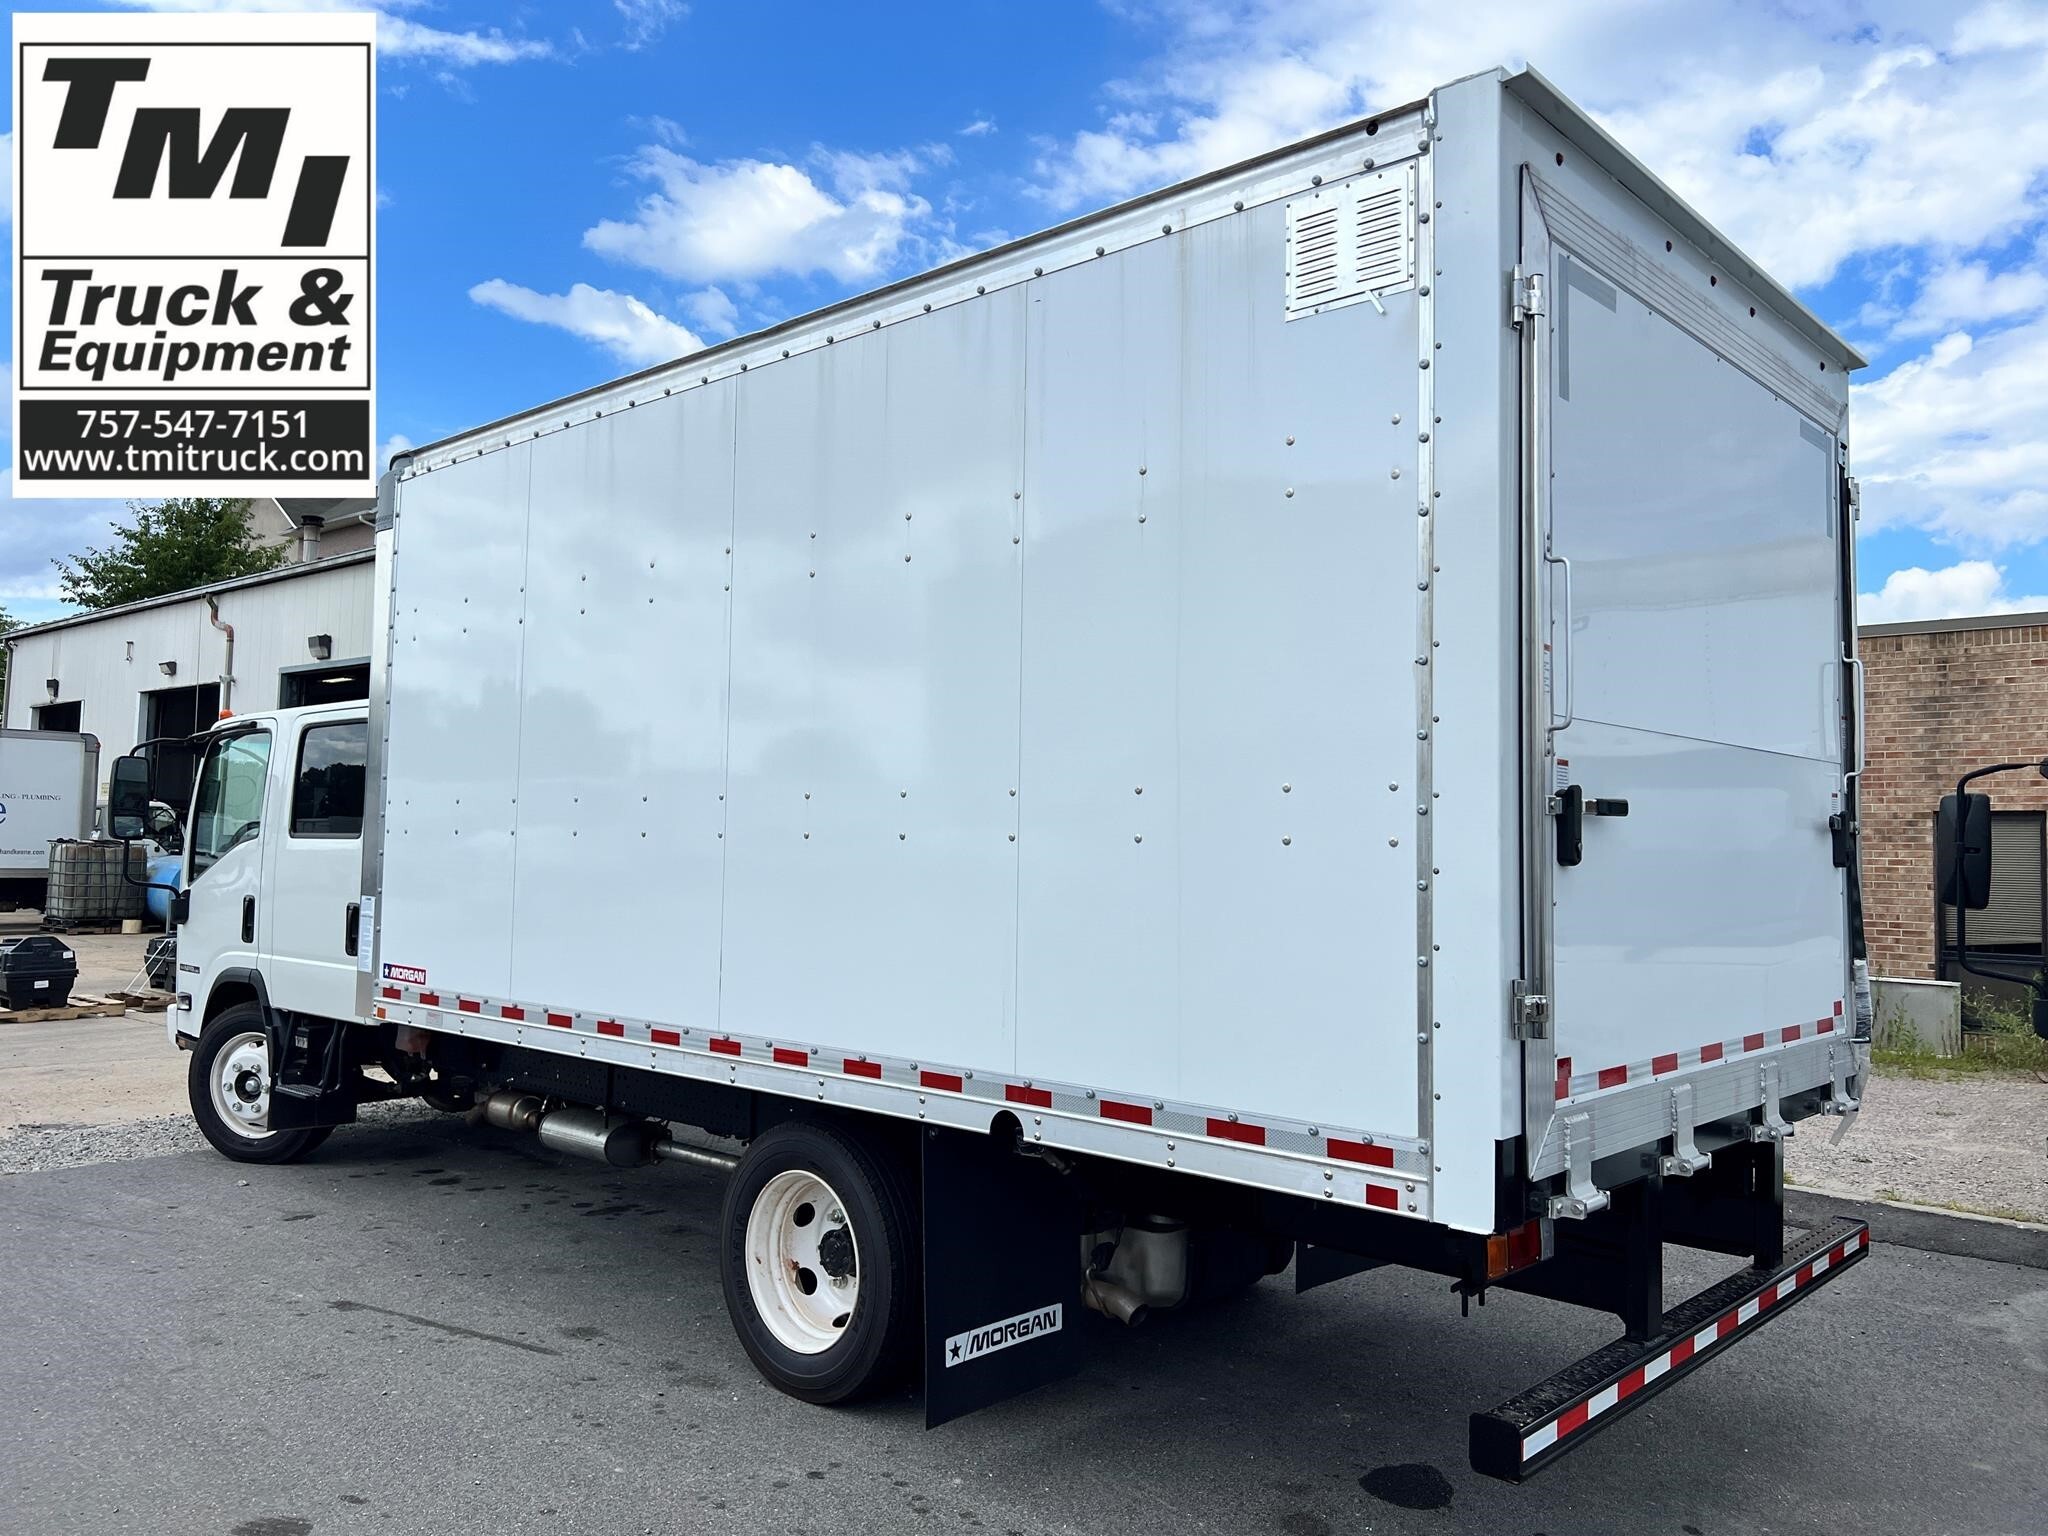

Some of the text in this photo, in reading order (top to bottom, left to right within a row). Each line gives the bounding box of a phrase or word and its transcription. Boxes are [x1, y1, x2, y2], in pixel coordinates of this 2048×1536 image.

[21, 793, 62, 801] PLUMBING
[390, 966, 425, 983] MORGAN
[968, 1309, 1057, 1355] MORGAN
